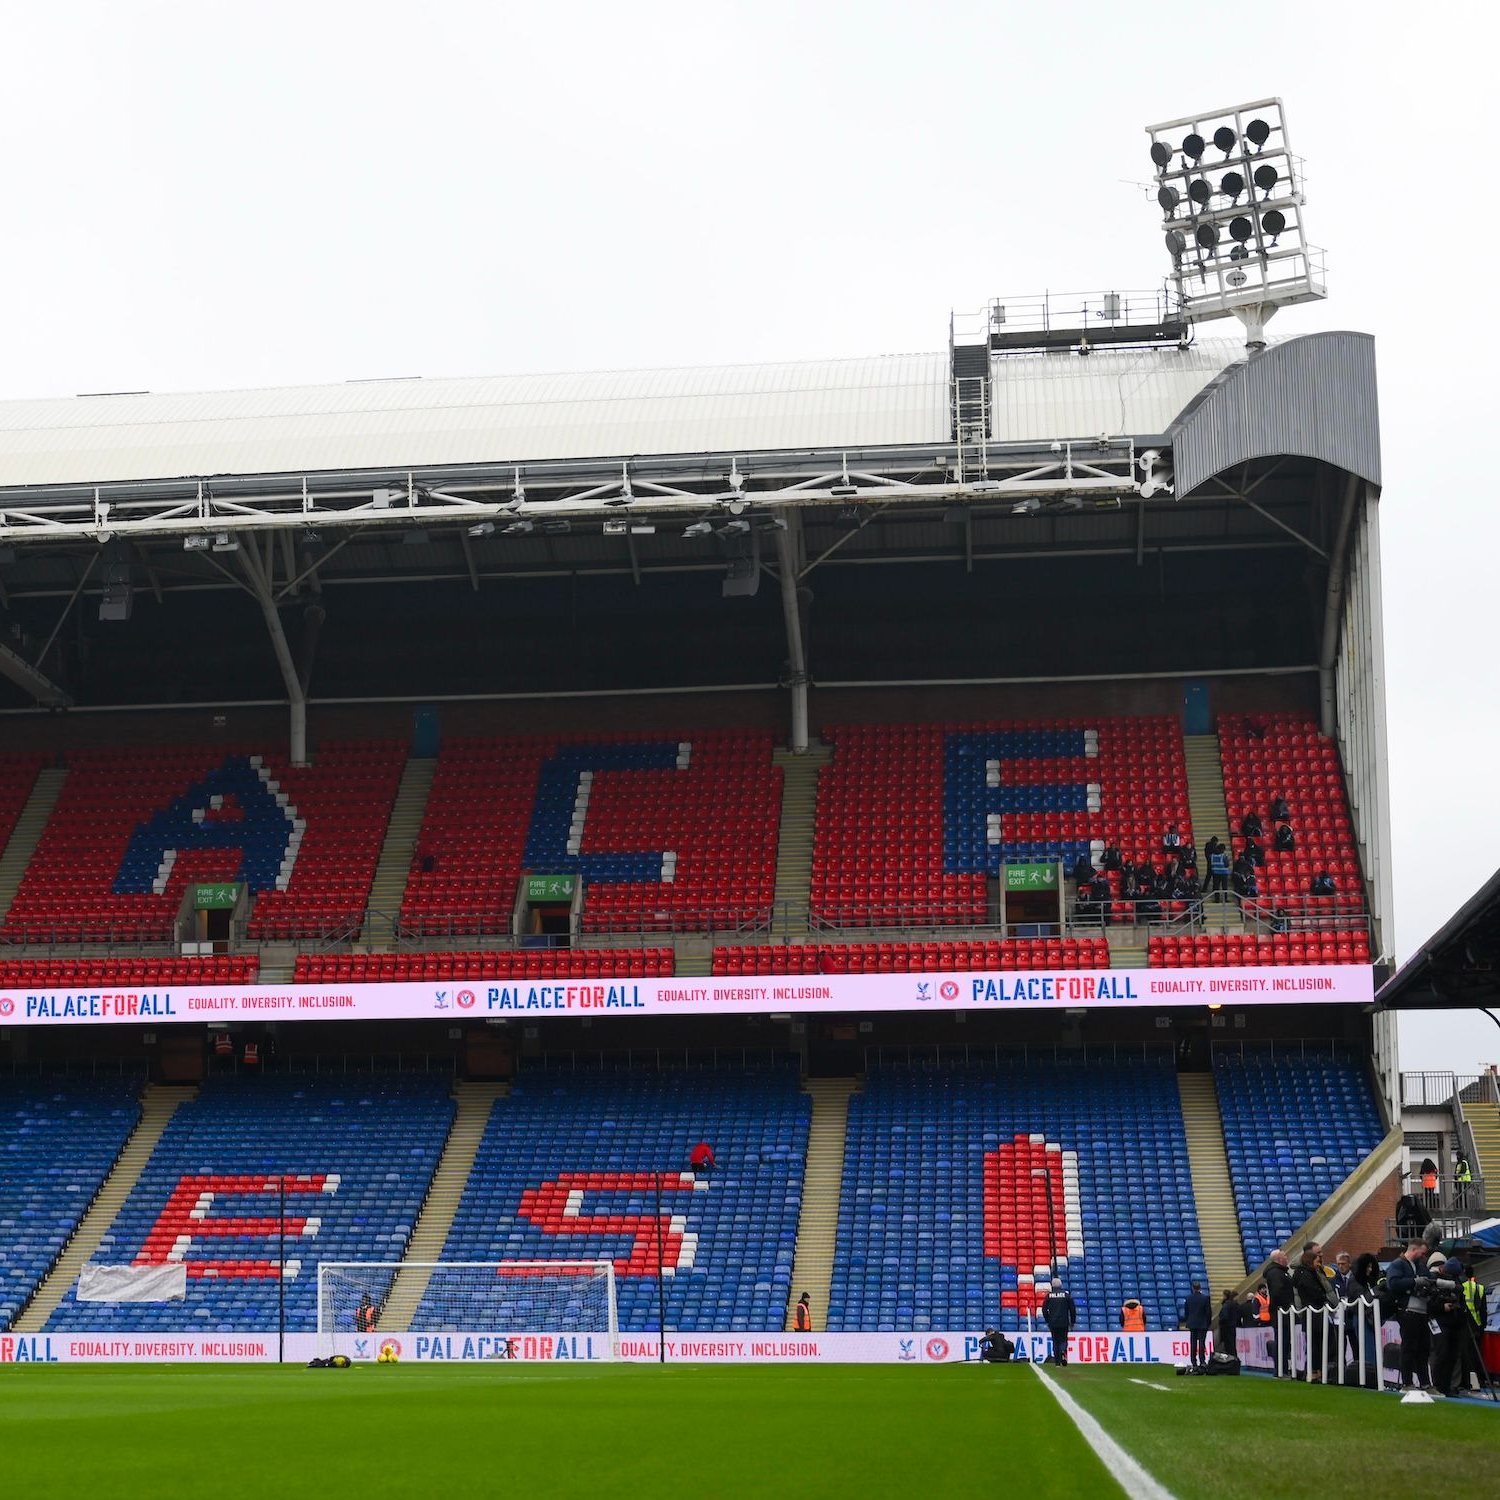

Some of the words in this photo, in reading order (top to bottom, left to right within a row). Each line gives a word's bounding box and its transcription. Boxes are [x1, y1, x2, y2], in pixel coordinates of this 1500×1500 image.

[488, 986, 645, 1009] PALACEFORALL
[657, 989, 710, 1001] EQUALITY.
[713, 988, 770, 1000] DIVERSITY.
[773, 987, 833, 999] INCLUSION.
[973, 977, 1138, 1001] PALACEFORALL
[1150, 980, 1205, 993] EQUALITY.
[1209, 979, 1268, 992] DIVERSITY.
[1272, 978, 1336, 991] INCLUSION.
[26, 994, 177, 1017] PALACEFORALL
[188, 997, 238, 1009] EQUALITY.
[241, 997, 296, 1009] DIVERSITY.
[299, 996, 356, 1008] INCLUSION.
[70, 1342, 133, 1357] EQUALITY.
[135, 1342, 197, 1357] DIVERSITY.
[201, 1342, 268, 1357] INCLUSION.
[681, 1342, 747, 1357] DIVERSITY.
[751, 1342, 821, 1357] INCLUSION.
